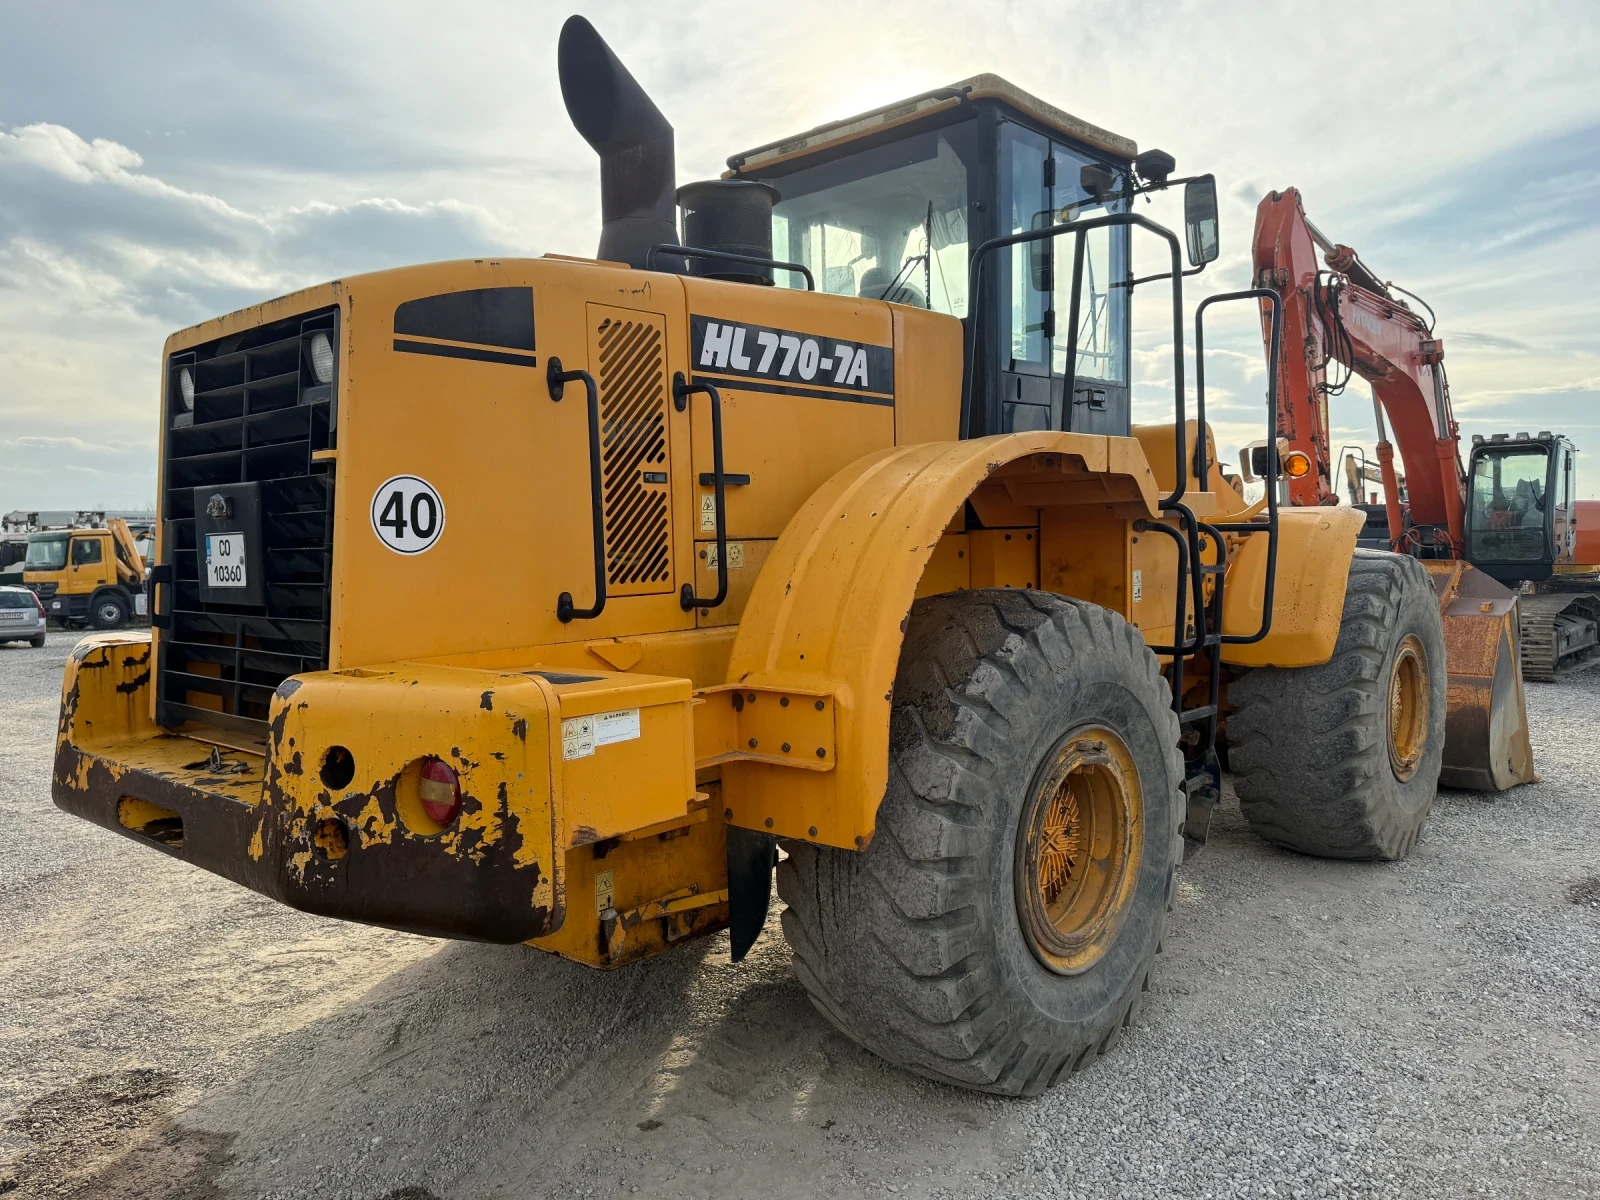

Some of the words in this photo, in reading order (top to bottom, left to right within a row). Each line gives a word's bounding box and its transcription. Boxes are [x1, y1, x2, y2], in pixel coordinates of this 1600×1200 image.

[699, 322, 751, 371] HL
[756, 331, 869, 387] 770-7A
[379, 490, 437, 539] 40
[219, 538, 231, 557] CO
[213, 565, 242, 582] 10360
